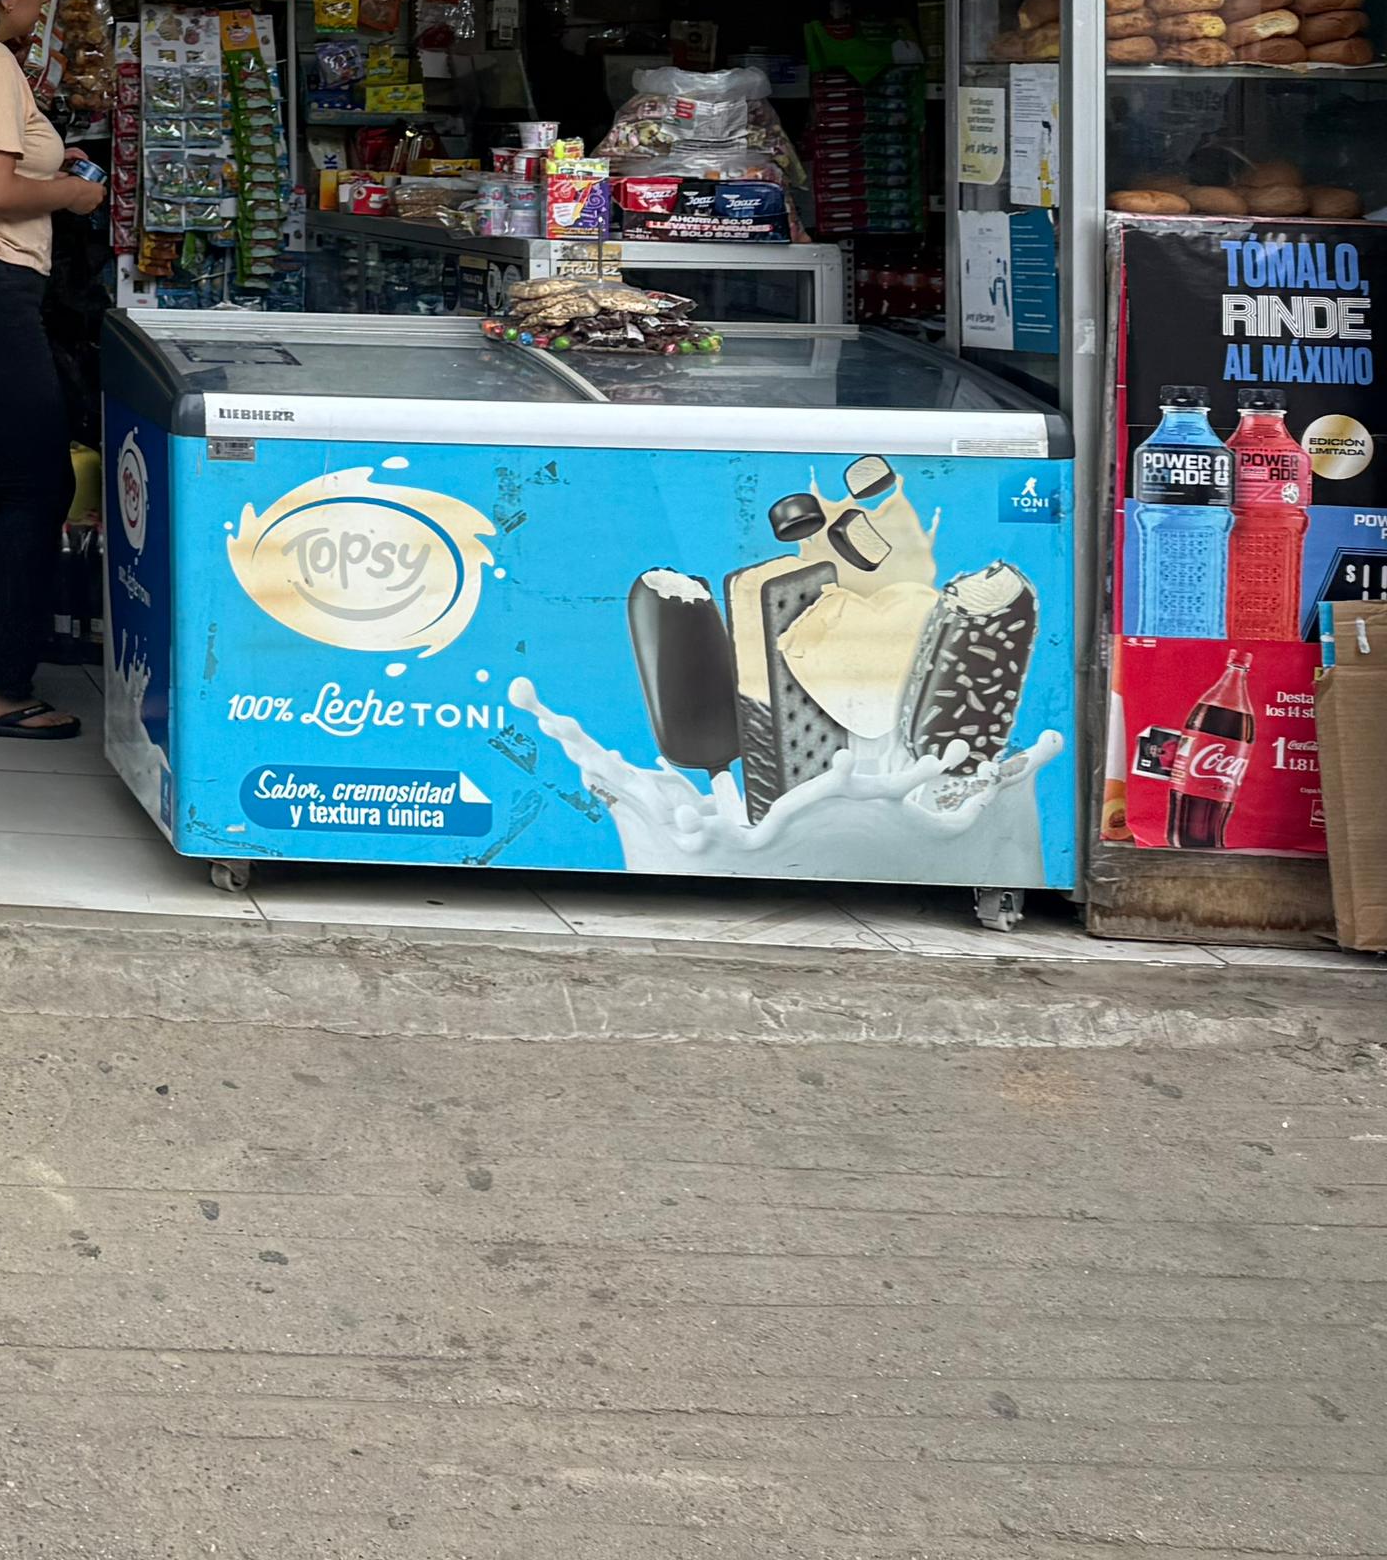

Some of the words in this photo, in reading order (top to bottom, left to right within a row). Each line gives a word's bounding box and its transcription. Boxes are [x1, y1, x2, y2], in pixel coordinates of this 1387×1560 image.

[669, 216, 721, 225] AHORRA
[711, 224, 772, 233] UNIDADES
[1221, 233, 1369, 295] TÓMALO,
[1222, 294, 1372, 340] RINDE
[1223, 343, 1257, 381] AL
[1262, 339, 1373, 386] MÁXIMO
[218, 407, 296, 423] LIEBHERR
[1309, 436, 1365, 447] EDICIÓN
[1240, 453, 1299, 467] POWER
[1308, 447, 1365, 456] LIMITADA
[1143, 452, 1211, 470] POWER
[1170, 469, 1211, 485] ADE
[1269, 468, 1299, 481] ADE
[1011, 497, 1049, 507] TONI
[281, 525, 431, 593] Topsy
[227, 694, 294, 722] 100%
[301, 682, 405, 736] Leche
[410, 703, 504, 728] TONI
[1266, 704, 1285, 717] los
[1272, 737, 1287, 770] 1
[1190, 743, 1248, 786] Coca
[254, 770, 326, 802] Sabor,
[332, 781, 456, 805] cremosidad
[290, 805, 302, 827] y
[309, 802, 381, 825] textura
[387, 803, 444, 828] única
